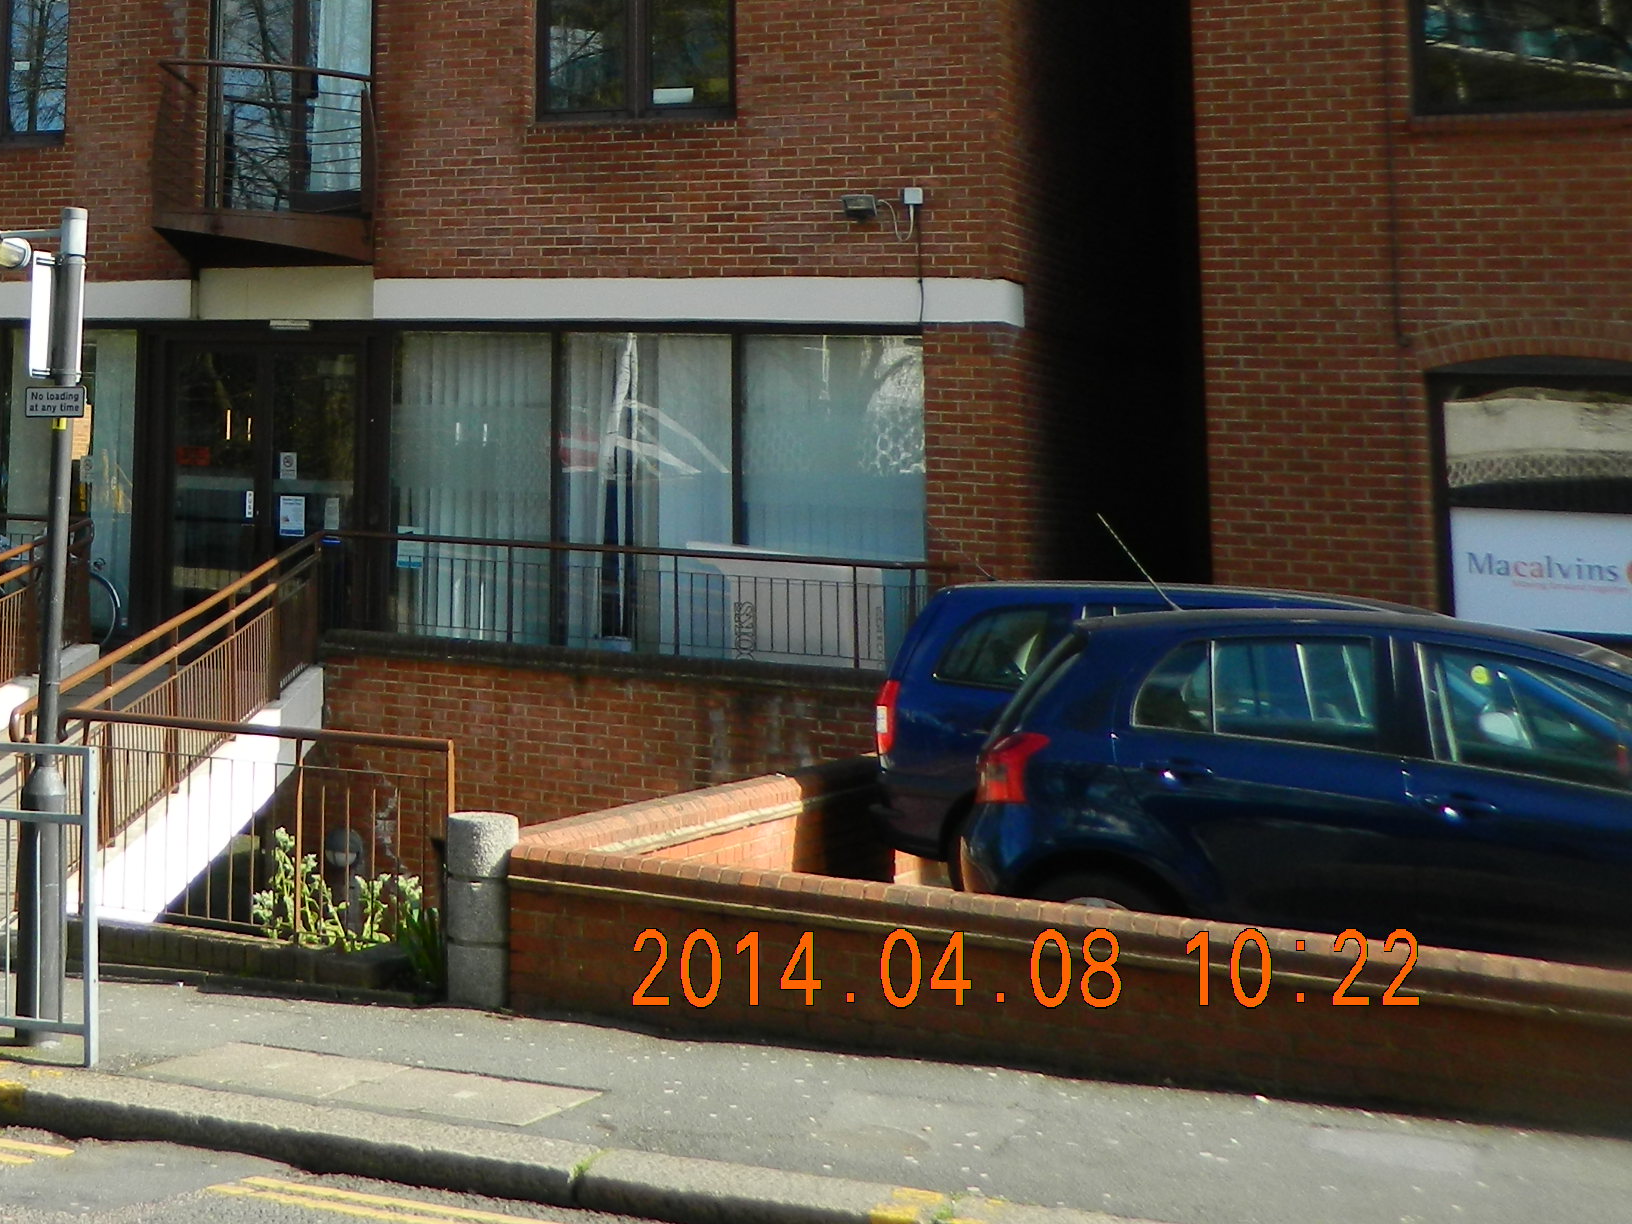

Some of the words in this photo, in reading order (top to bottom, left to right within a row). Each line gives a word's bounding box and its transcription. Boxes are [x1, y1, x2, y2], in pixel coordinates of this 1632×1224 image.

[31, 392, 43, 401] No
[47, 392, 79, 402] loading
[29, 404, 38, 412] at
[41, 404, 56, 413] any
[60, 403, 79, 412] time
[1467, 551, 1618, 582] Macalvins
